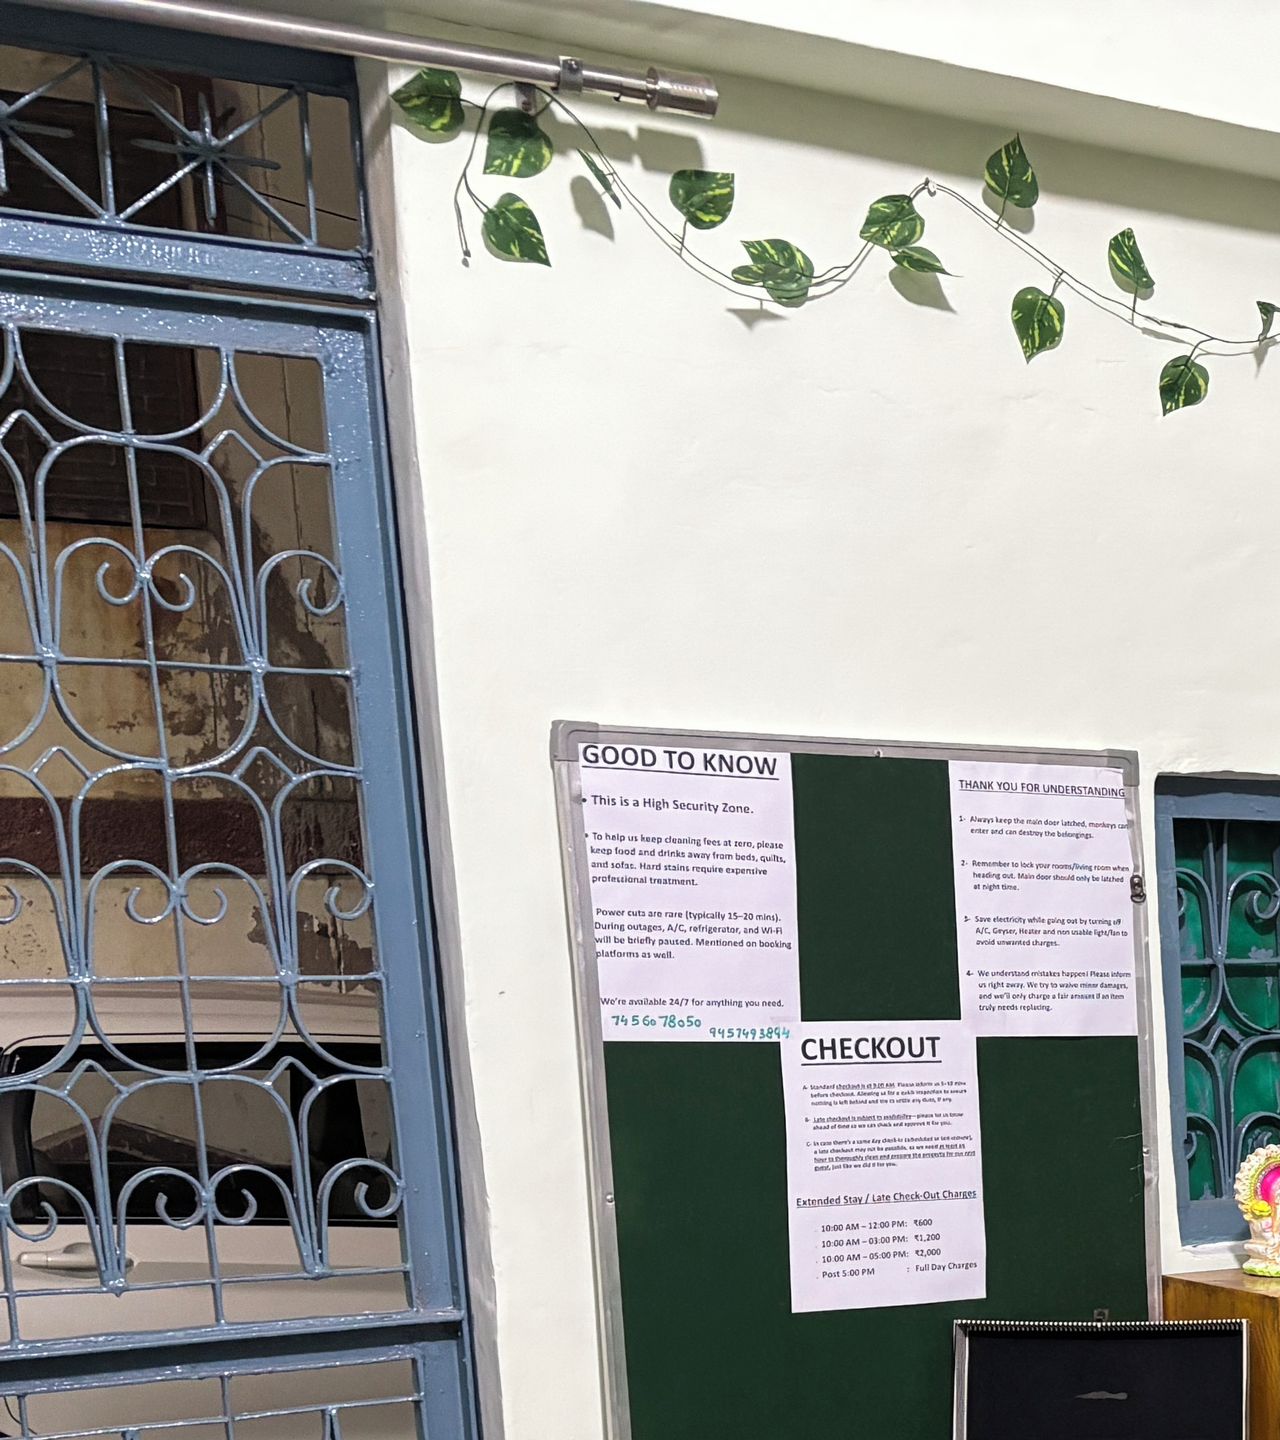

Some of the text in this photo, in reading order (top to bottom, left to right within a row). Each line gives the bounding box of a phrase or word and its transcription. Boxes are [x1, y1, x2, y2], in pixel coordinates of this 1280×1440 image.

[582, 745, 777, 775] GOOD TO KNOW
[958, 780, 1125, 797] THANK YOU FOR UNDERSTANDING
[591, 795, 616, 806] This
[621, 797, 629, 807] is
[643, 799, 669, 810] High
[673, 800, 719, 814] Security
[722, 803, 753, 814] Zone.
[592, 832, 602, 840] To
[605, 833, 625, 843] help
[641, 835, 662, 844] keep
[665, 836, 701, 846] cleaning
[704, 837, 721, 846] fees
[757, 841, 783, 850] please
[590, 846, 612, 856] keep
[615, 847, 636, 856] food
[639, 848, 655, 857] and
[658, 849, 685, 858] drinks
[688, 852, 710, 861] away
[713, 852, 733, 860] from
[591, 861, 608, 869] and
[640, 862, 661, 871] Hard
[664, 863, 689, 872] stains
[692, 865, 723, 876] require
[726, 868, 767, 877] expensive
[592, 875, 698, 886] professional treatment.
[596, 908, 625, 916] Power
[627, 909, 646, 917] cuts
[665, 911, 683, 919] rare
[686, 910, 726, 921] (typically
[594, 922, 625, 932] During
[627, 924, 665, 933] outages,
[689, 925, 741, 935] refrigerator,
[744, 926, 759, 934] and
[595, 936, 611, 944] will
[614, 936, 625, 944] be
[627, 937, 656, 947] briefly
[659, 938, 693, 947] paused.
[696, 938, 743, 947] Mentioned
[759, 940, 792, 949] booking
[596, 950, 639, 960] platforms
[653, 951, 674, 959] well.
[629, 998, 666, 1006] available
[669, 998, 689, 1007] 24/7
[692, 998, 703, 1006] for
[706, 999, 743, 1008] anything
[745, 1000, 759, 1008] you
[762, 999, 784, 1007] need.
[801, 1037, 940, 1060] CHECKOUT
[796, 1190, 977, 1207] Extended Stay Late Check-Out Charges
[821, 1224, 843, 1232] 10:00
[822, 1240, 844, 1248] 10:00
[869, 1236, 890, 1244] 03:00
[869, 1252, 891, 1260] 05:00
[893, 1250, 909, 1258] PM:
[822, 1261, 977, 1278] Post 5:00 PM Full Day Charges
